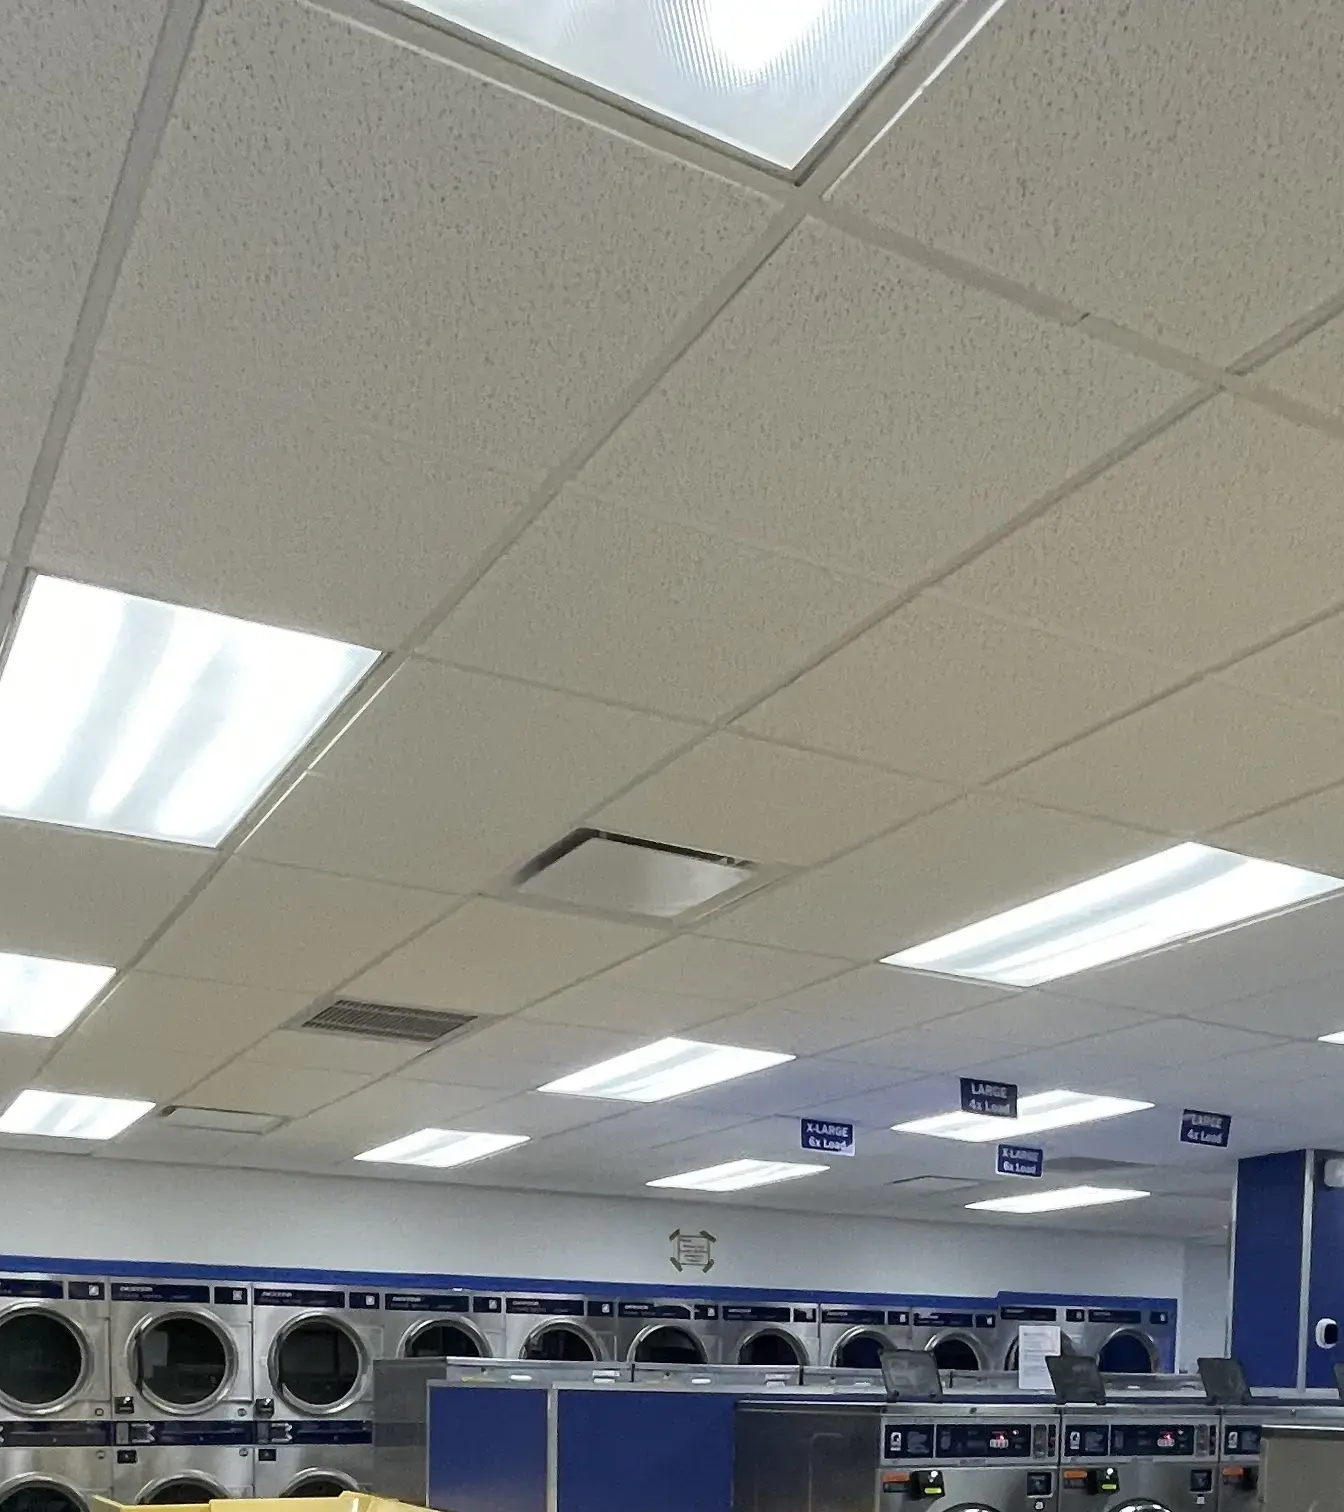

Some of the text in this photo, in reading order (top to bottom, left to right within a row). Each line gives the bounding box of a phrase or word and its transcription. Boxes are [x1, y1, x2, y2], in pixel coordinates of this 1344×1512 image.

[971, 1082, 1008, 1099] LARGE
[968, 1099, 983, 1111] 4x
[806, 1122, 849, 1138] X-LARGE
[823, 1138, 847, 1151] Load
